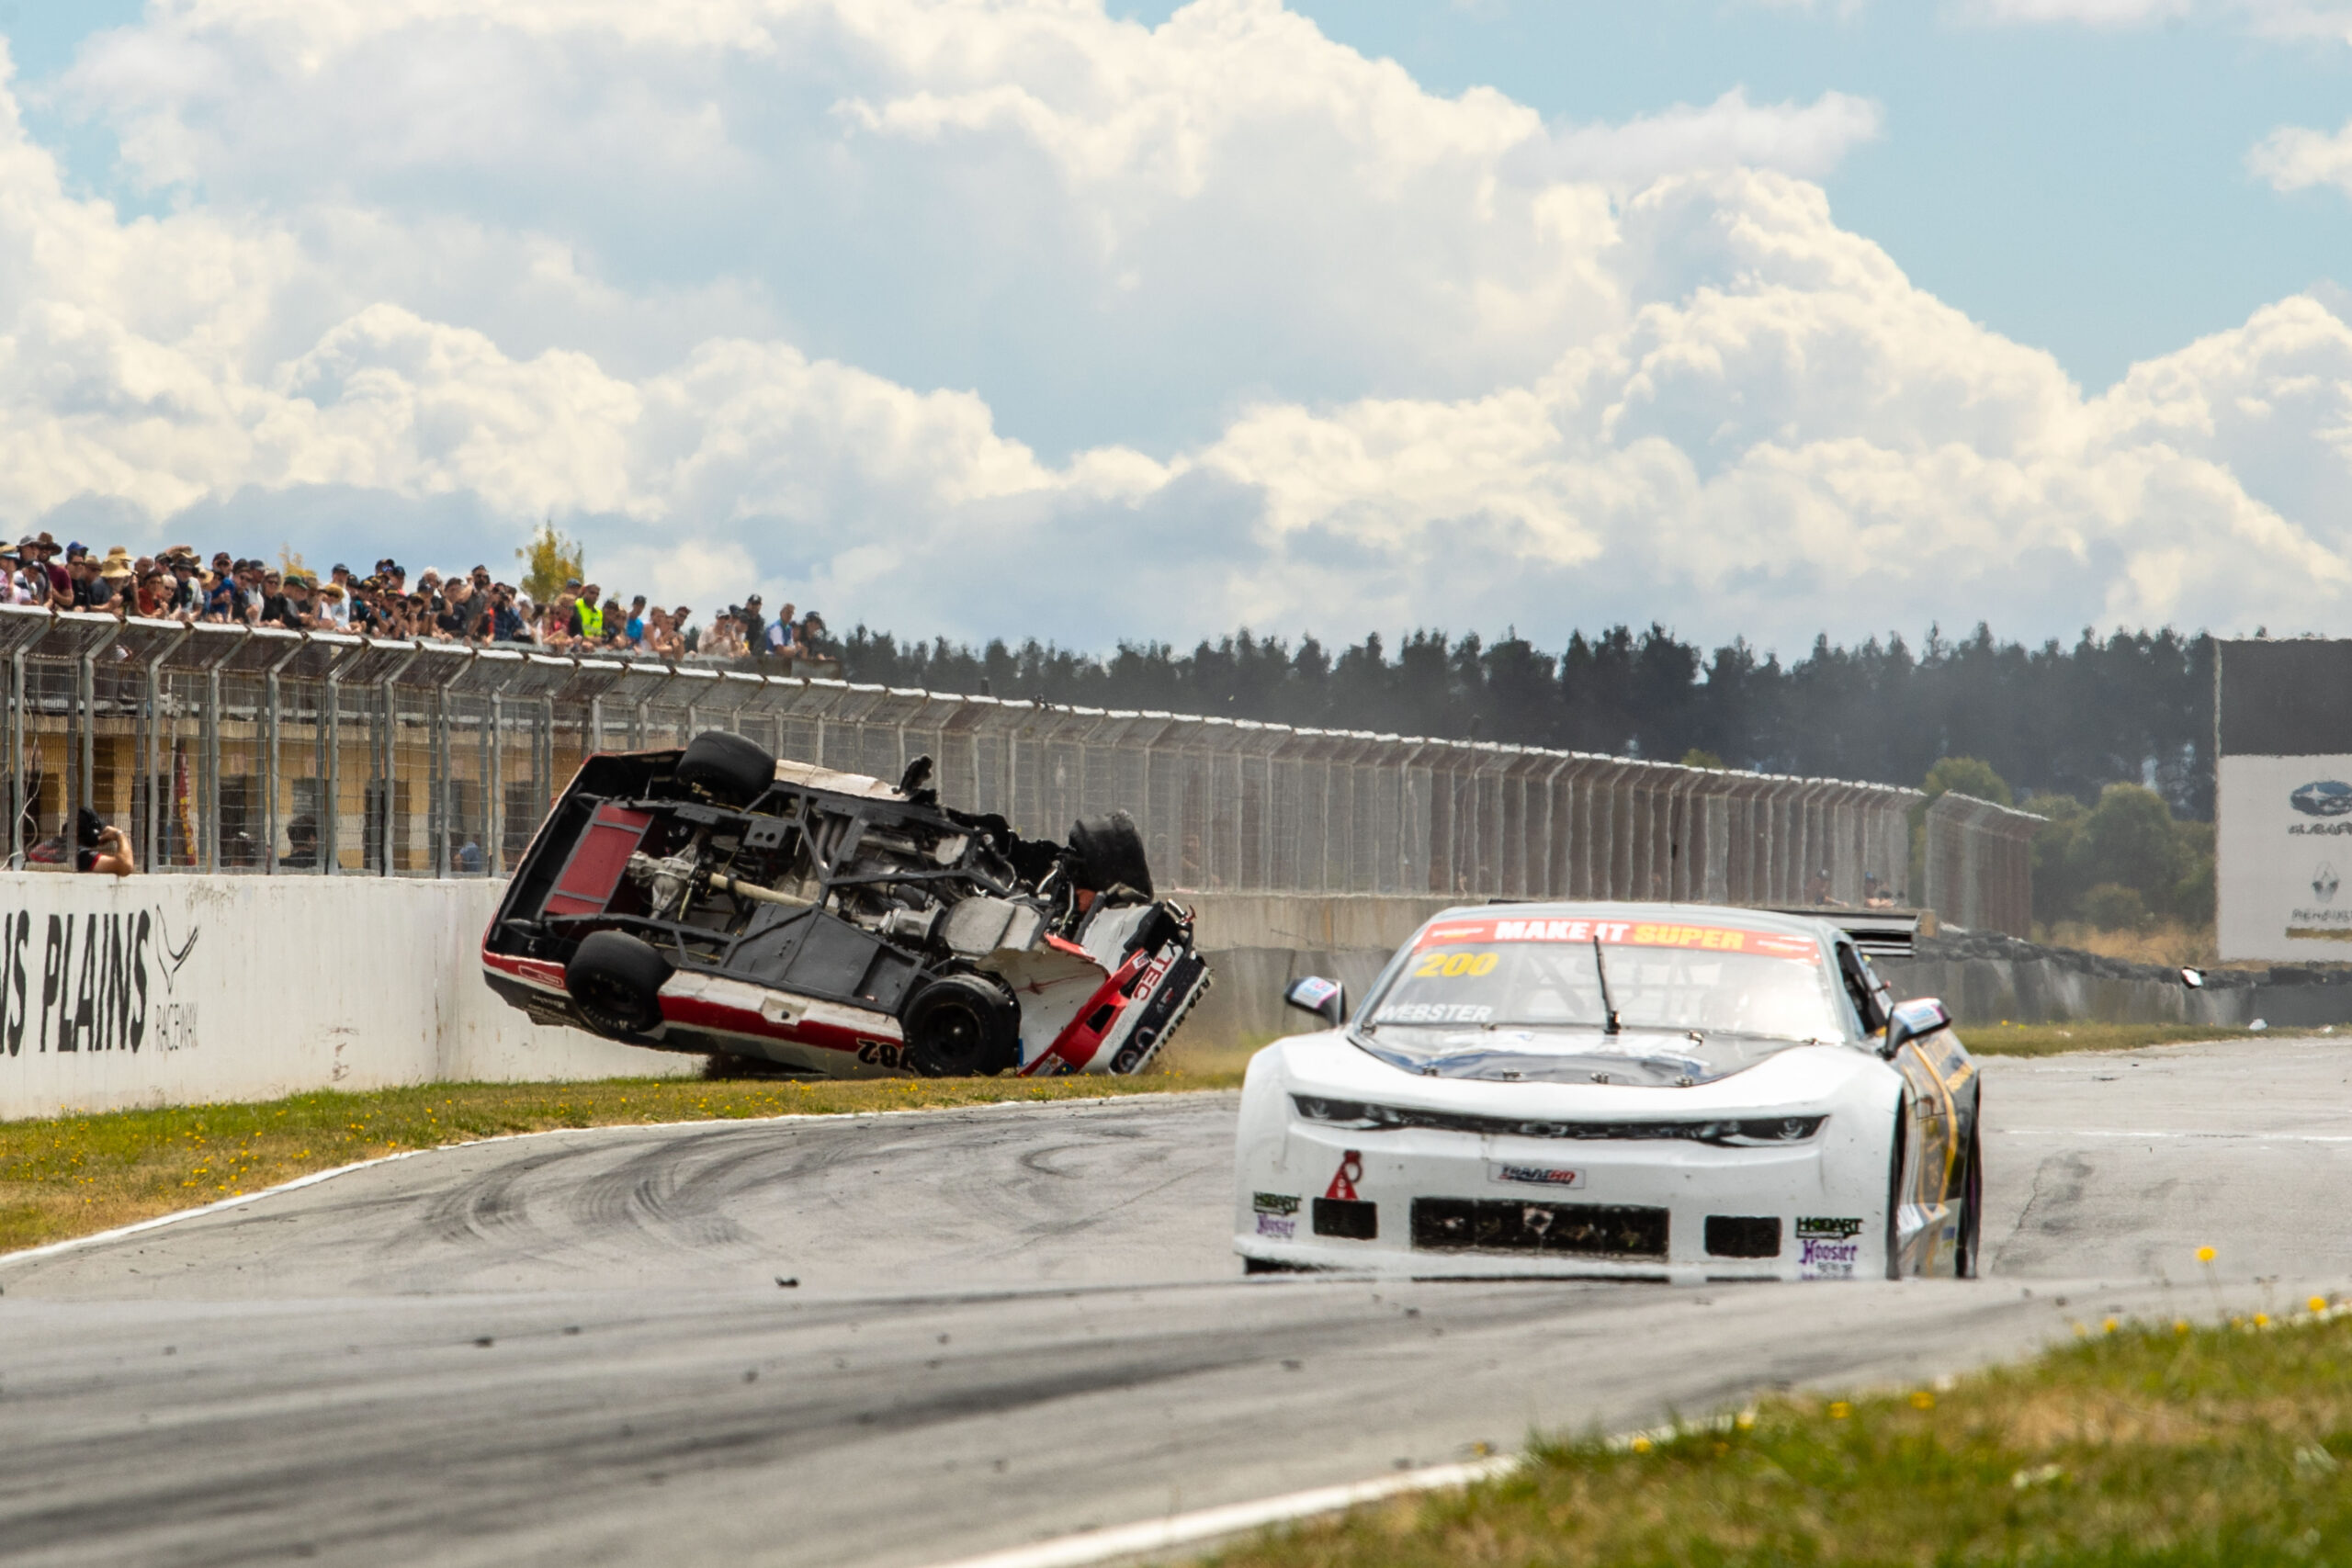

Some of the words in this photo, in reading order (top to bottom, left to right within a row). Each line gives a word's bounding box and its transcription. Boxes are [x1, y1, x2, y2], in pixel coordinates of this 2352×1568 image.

[1495, 920, 1590, 942] MAKE
[1596, 923, 1630, 942] IT
[1634, 924, 1744, 950] SUPER
[1415, 953, 1499, 977] 200
[40, 909, 151, 1054] PLAINS
[1376, 1002, 1492, 1021] WEBSTER
[1798, 1239, 1858, 1265] Hoosier
